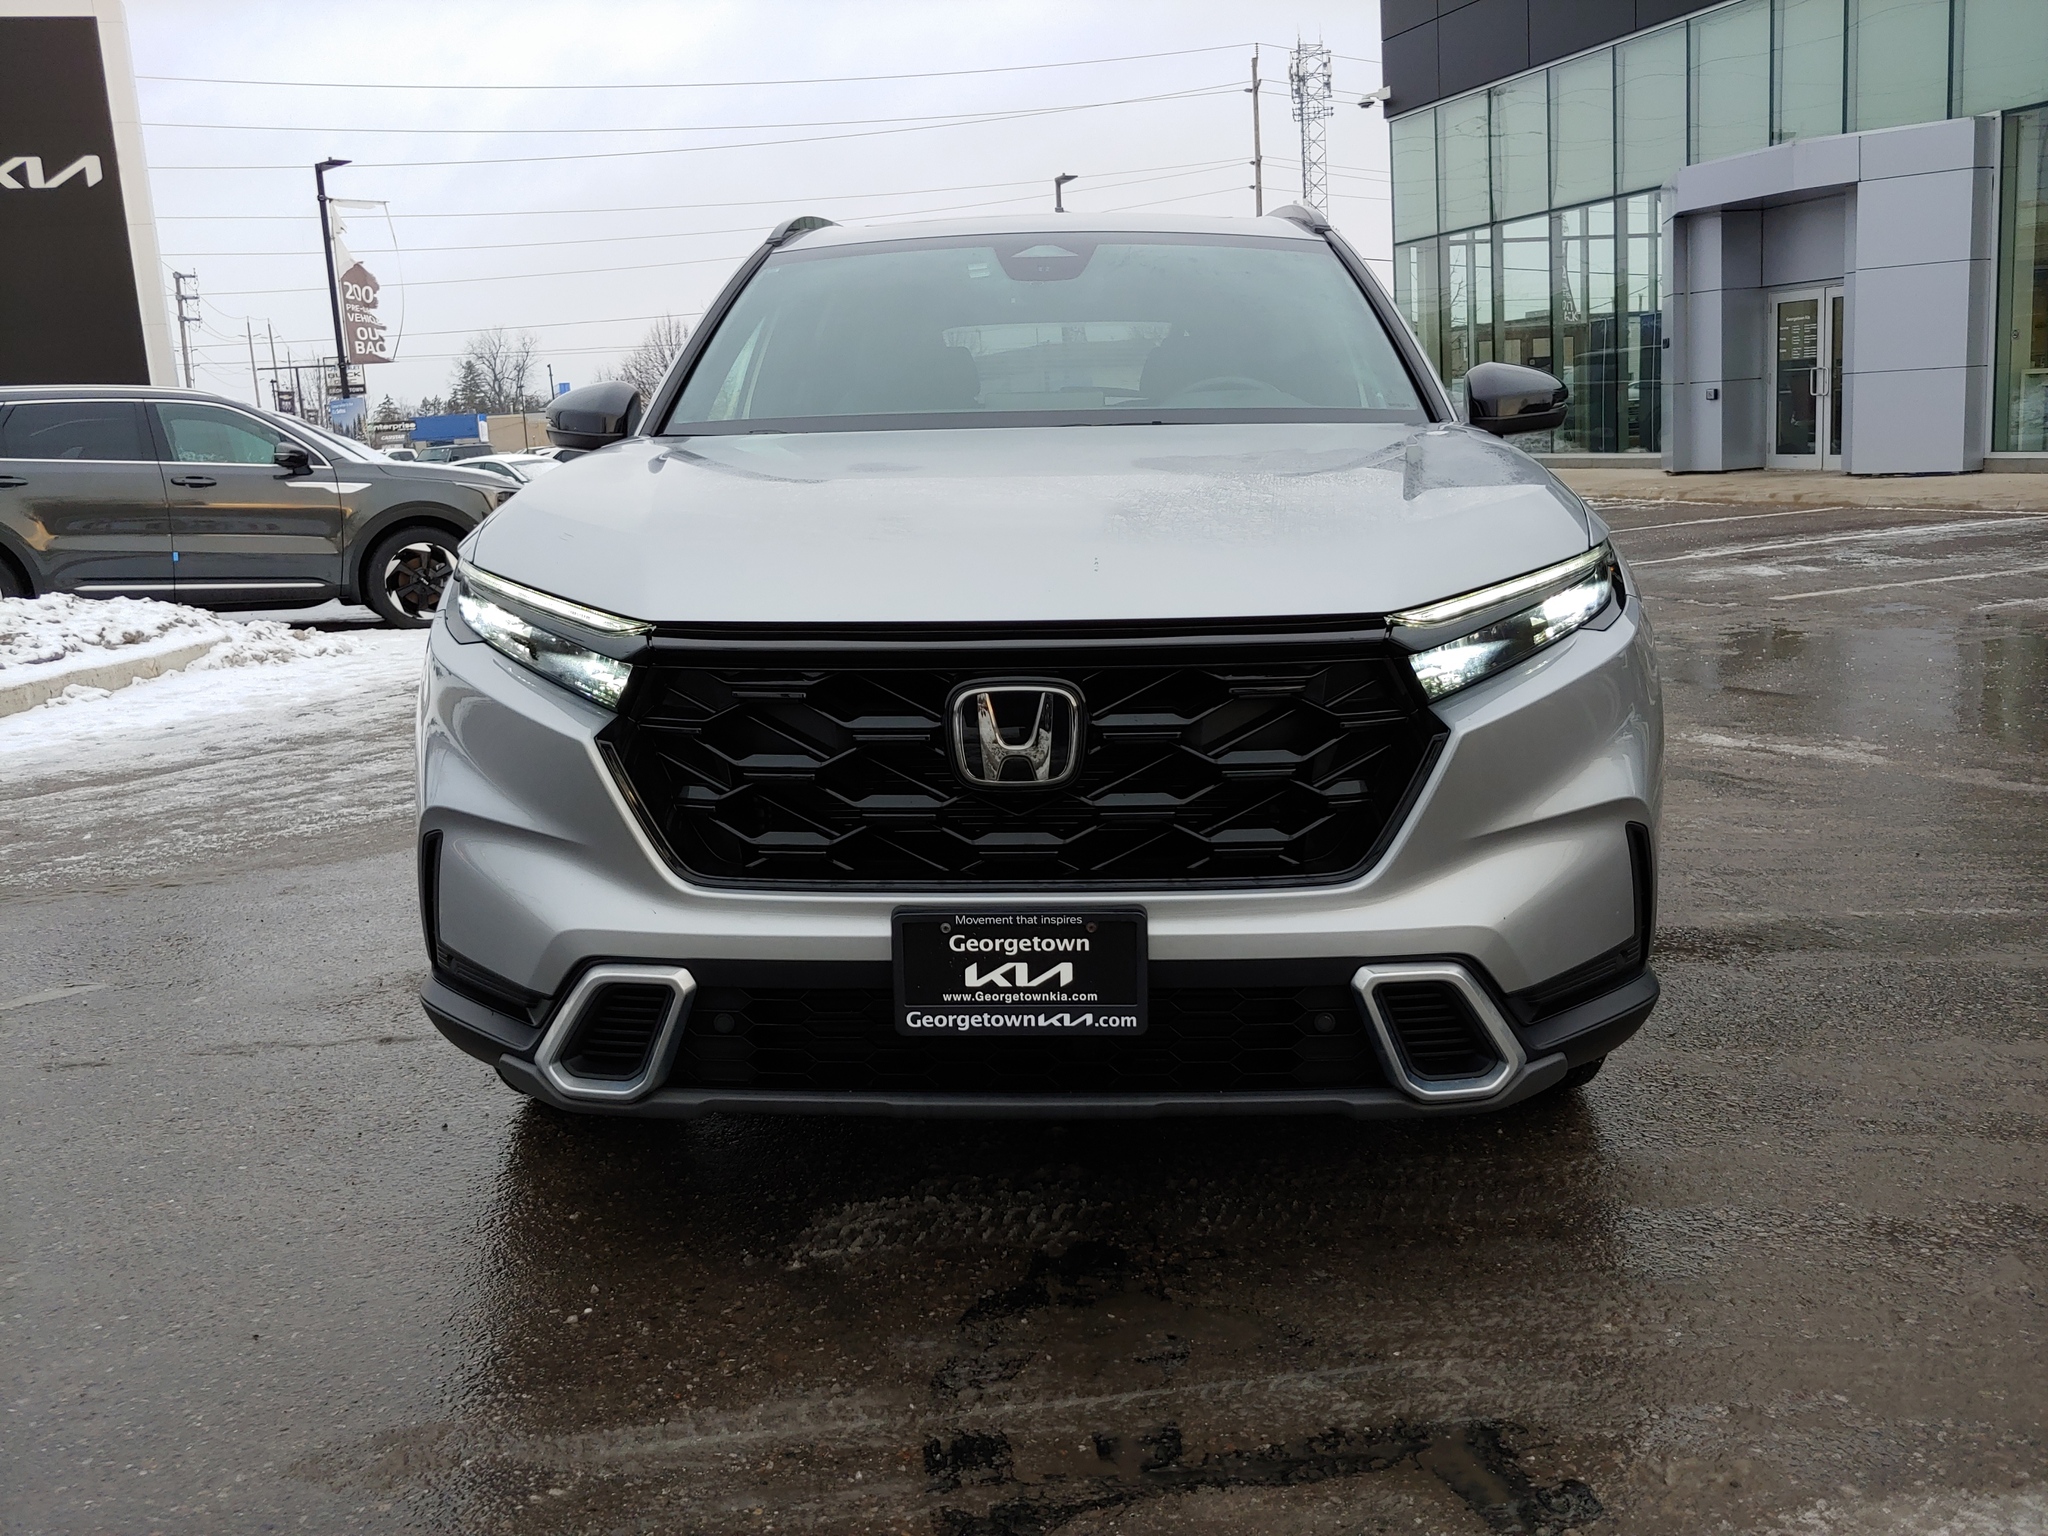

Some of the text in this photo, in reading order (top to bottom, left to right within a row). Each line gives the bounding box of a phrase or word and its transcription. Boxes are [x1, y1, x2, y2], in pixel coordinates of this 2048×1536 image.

[343, 281, 374, 304] 200
[955, 915, 1083, 926] Movement that inspires
[949, 934, 1090, 956] Georgetown
[964, 962, 1074, 987] KIA
[942, 991, 1099, 1004] www.Georgetownkia.com
